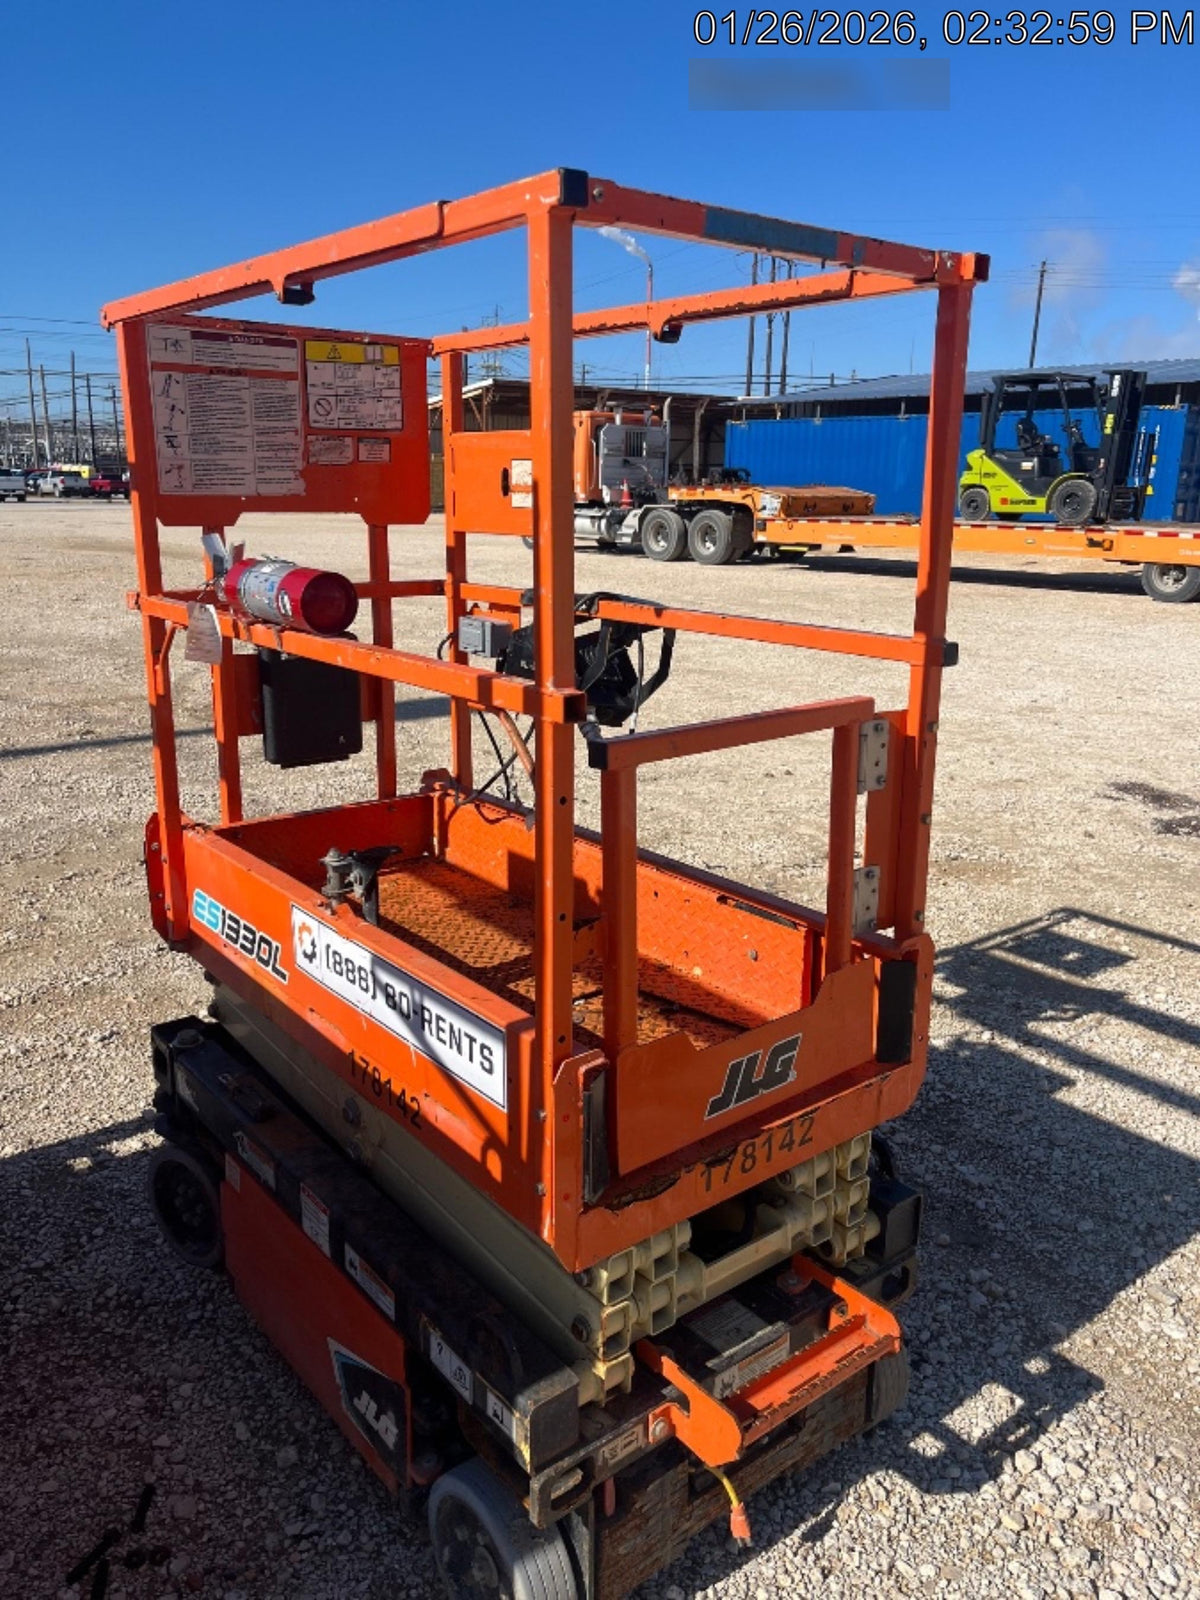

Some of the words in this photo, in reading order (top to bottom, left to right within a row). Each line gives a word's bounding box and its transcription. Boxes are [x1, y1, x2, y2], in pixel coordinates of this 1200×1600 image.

[193, 889, 289, 983] ES1330L
[325, 943, 377, 1000] (888)
[385, 982, 495, 1076] 80-RENTS
[349, 1048, 421, 1130] 178142
[704, 1033, 802, 1120] JLG
[700, 1110, 817, 1192] 178142
[353, 1389, 399, 1451] JLG
